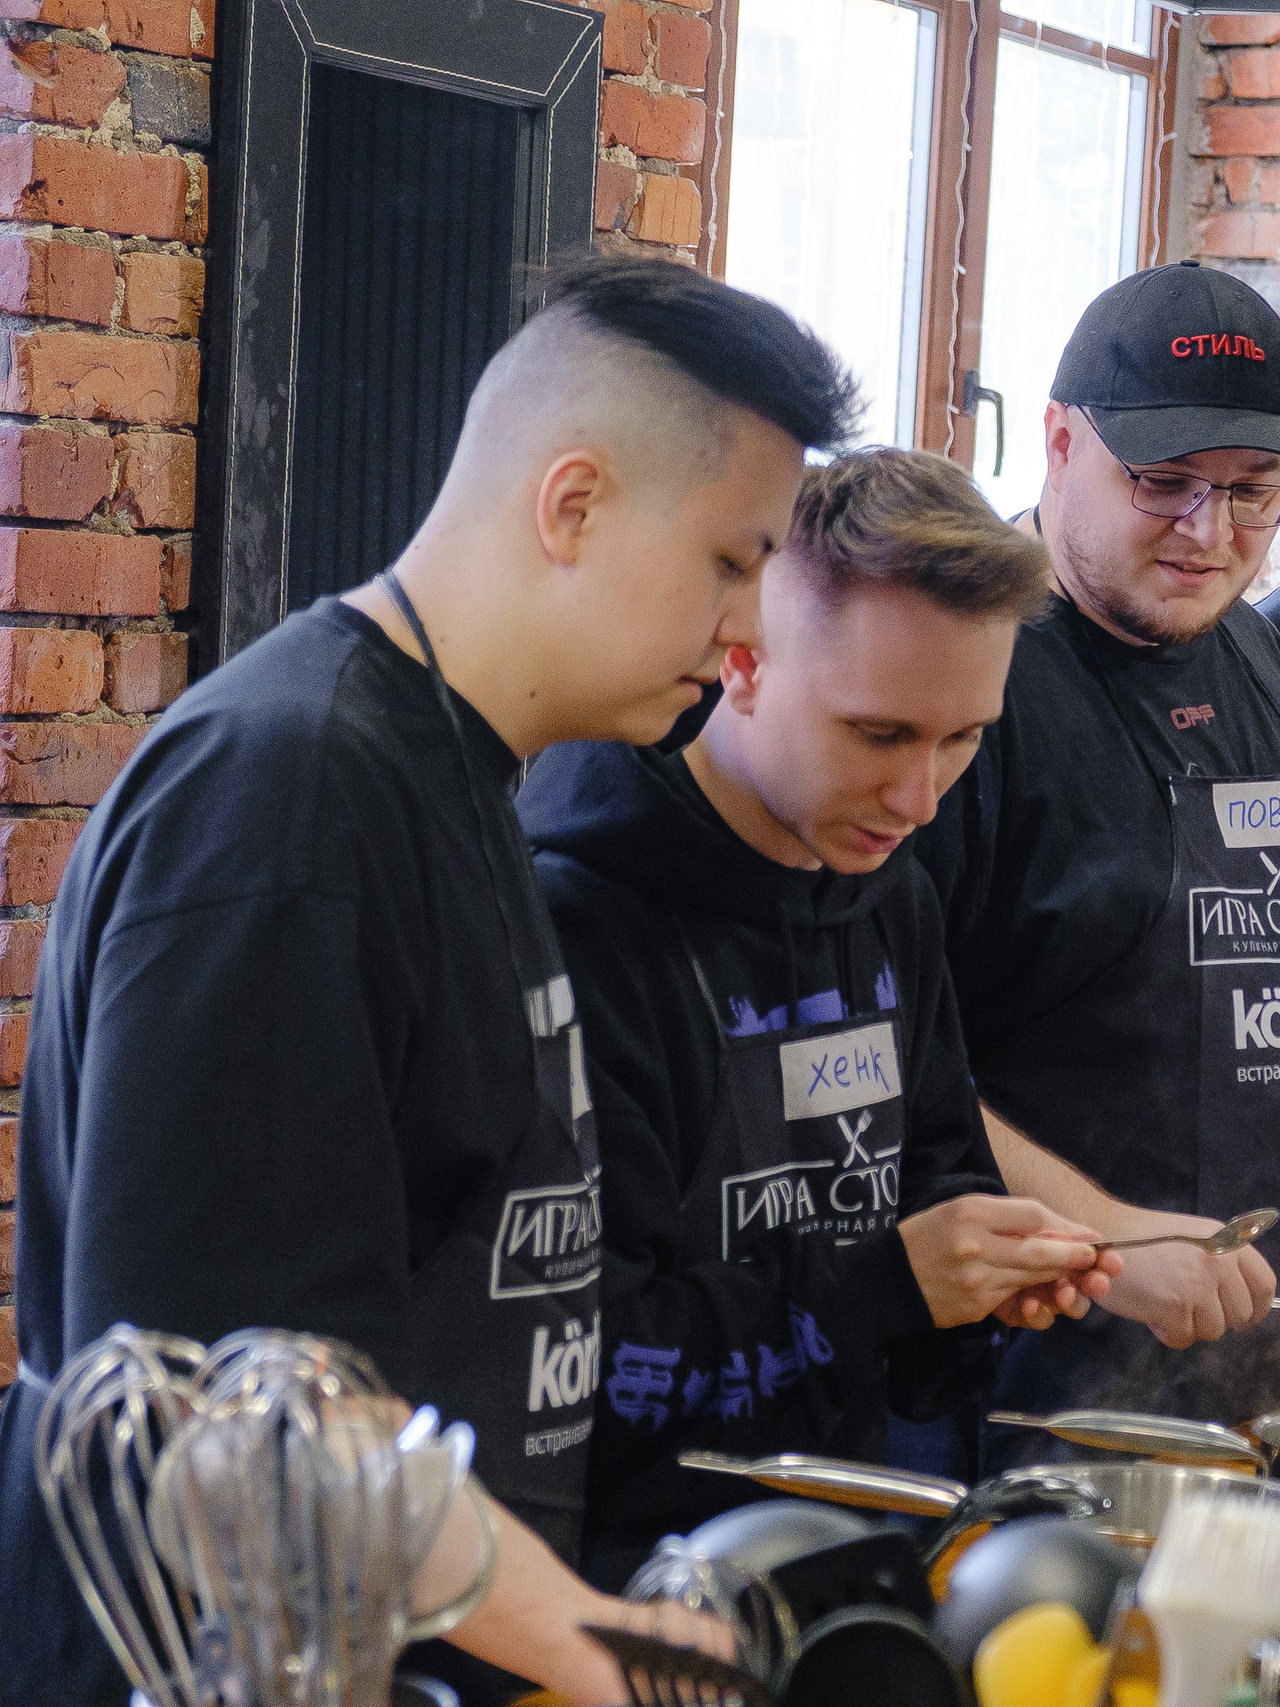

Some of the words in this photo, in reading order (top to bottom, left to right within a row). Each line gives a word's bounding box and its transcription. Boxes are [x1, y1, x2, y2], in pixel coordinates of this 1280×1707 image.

[1171, 333, 1265, 361] СТИЛЬ
[1200, 898, 1266, 936] ИГРА
[737, 1177, 815, 1231] ИГРА
[830, 1162, 898, 1212] СТО
[507, 1201, 589, 1257] ИГРА
[528, 1310, 600, 1412] kört
